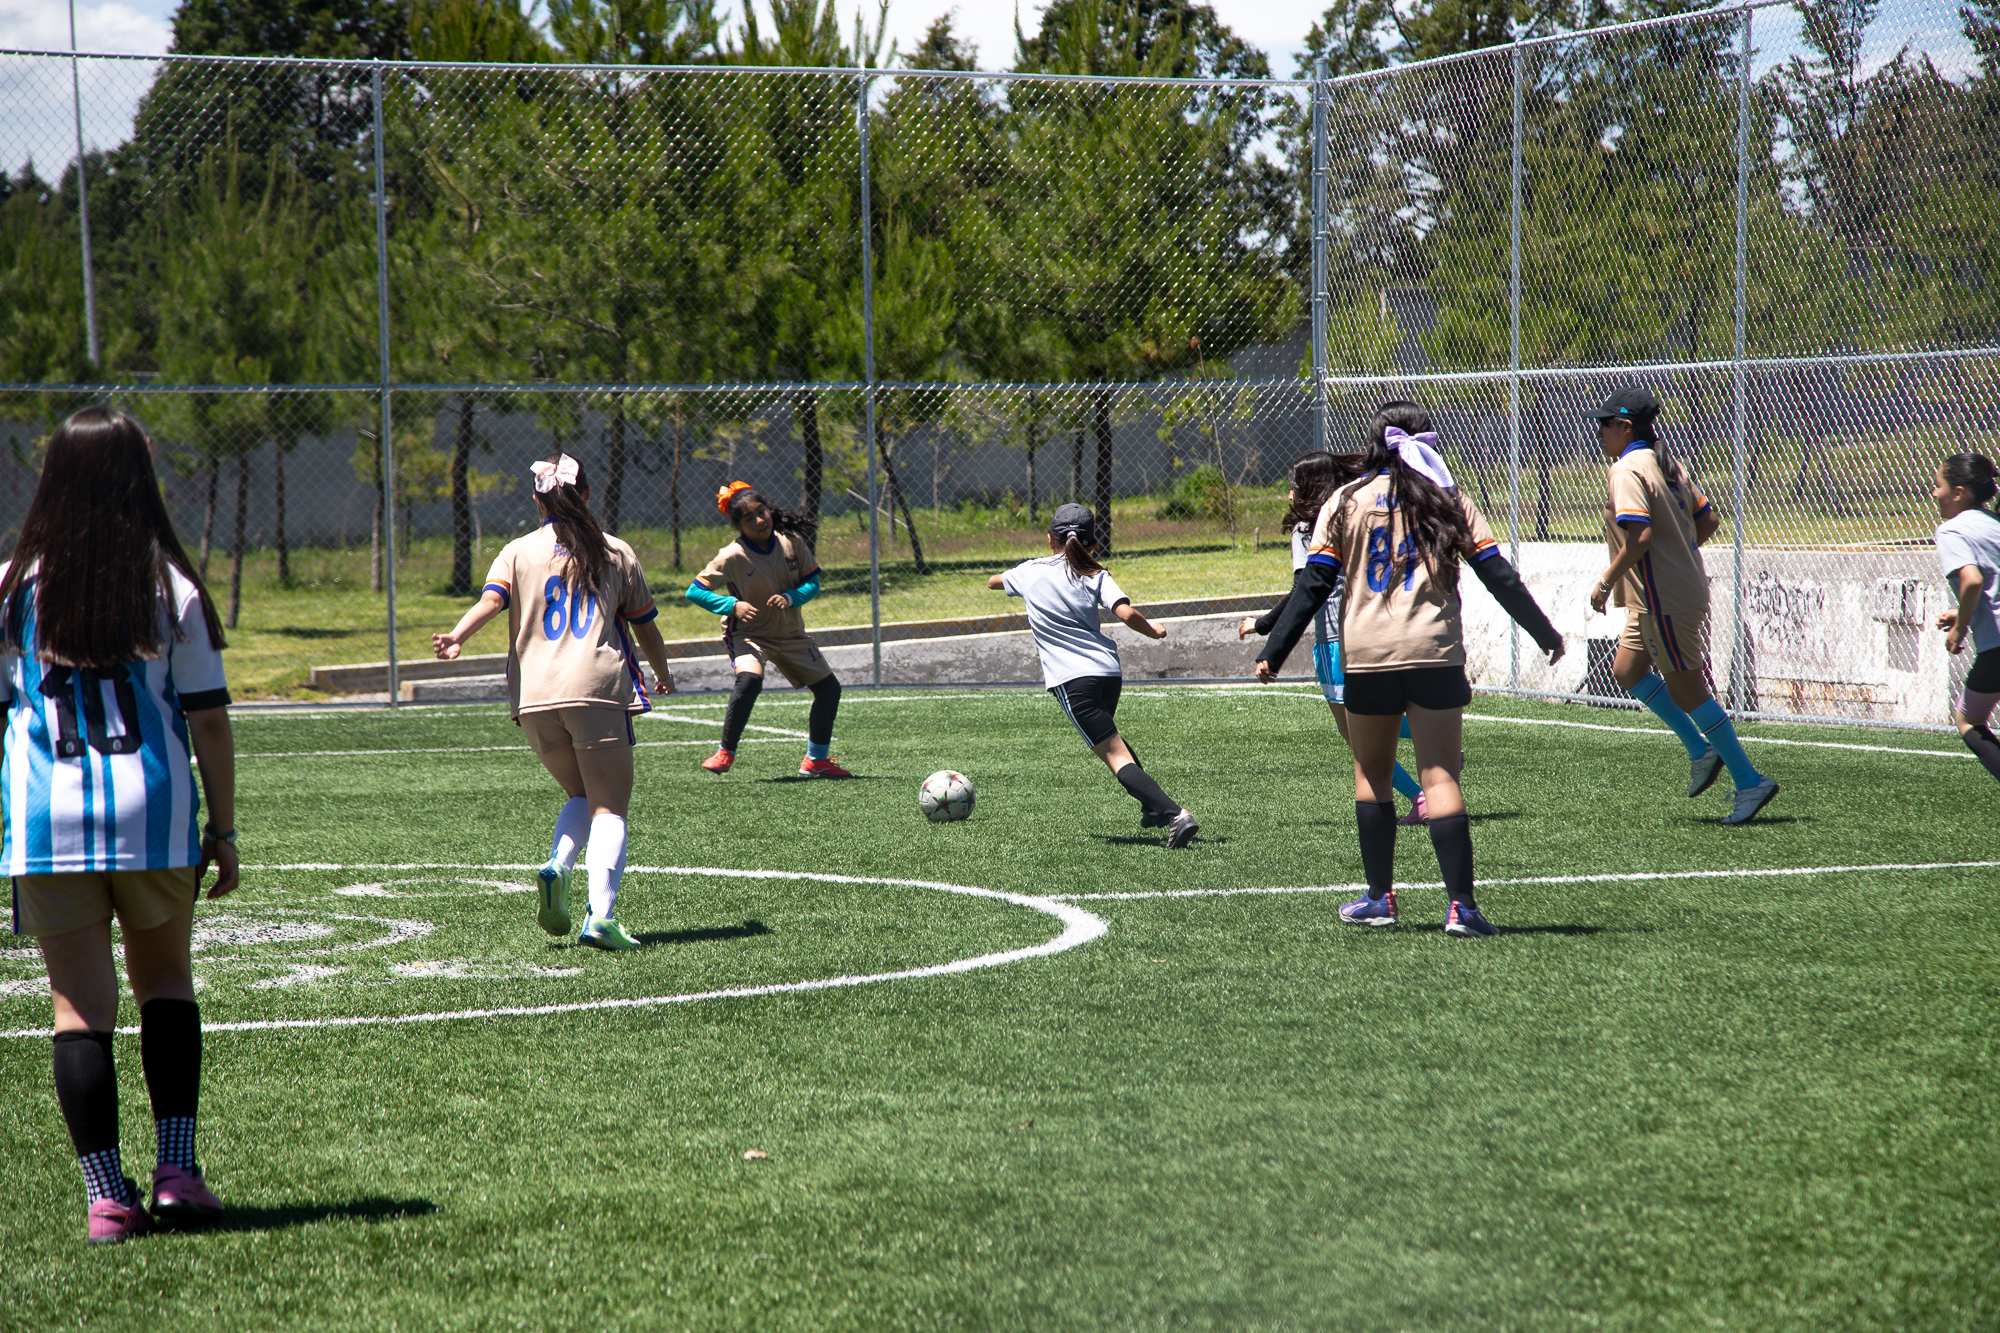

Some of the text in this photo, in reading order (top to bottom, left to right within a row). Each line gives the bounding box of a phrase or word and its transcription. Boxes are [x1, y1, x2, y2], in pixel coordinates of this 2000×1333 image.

[1367, 527, 1418, 593] 81
[543, 575, 596, 641] 80
[1648, 638, 1659, 656] 5
[38, 663, 144, 758] 10
